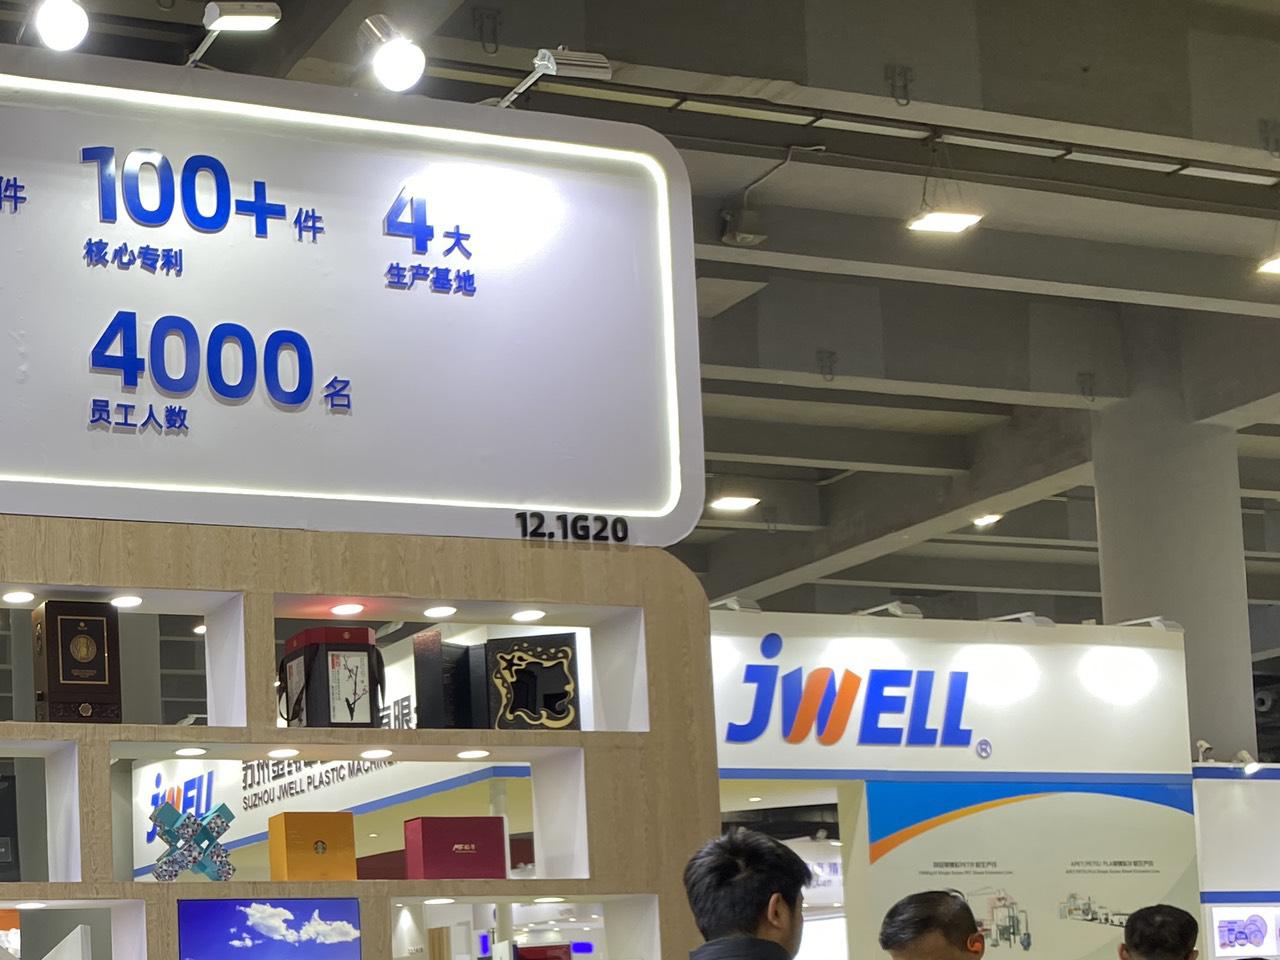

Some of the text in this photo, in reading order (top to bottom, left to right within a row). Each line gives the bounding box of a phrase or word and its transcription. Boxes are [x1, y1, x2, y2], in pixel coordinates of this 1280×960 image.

[81, 145, 326, 243] 100+ 件
[383, 185, 473, 260] 4 大
[82, 237, 184, 278] 核心专利
[384, 261, 478, 297] 生产基地
[91, 310, 353, 412] 4000 名
[89, 398, 191, 432] 员工人数
[515, 511, 630, 543] 12.1G20
[242, 787, 275, 811] SUZHOU
[276, 779, 305, 802] JWELL
[307, 763, 346, 792] PLASTIC
